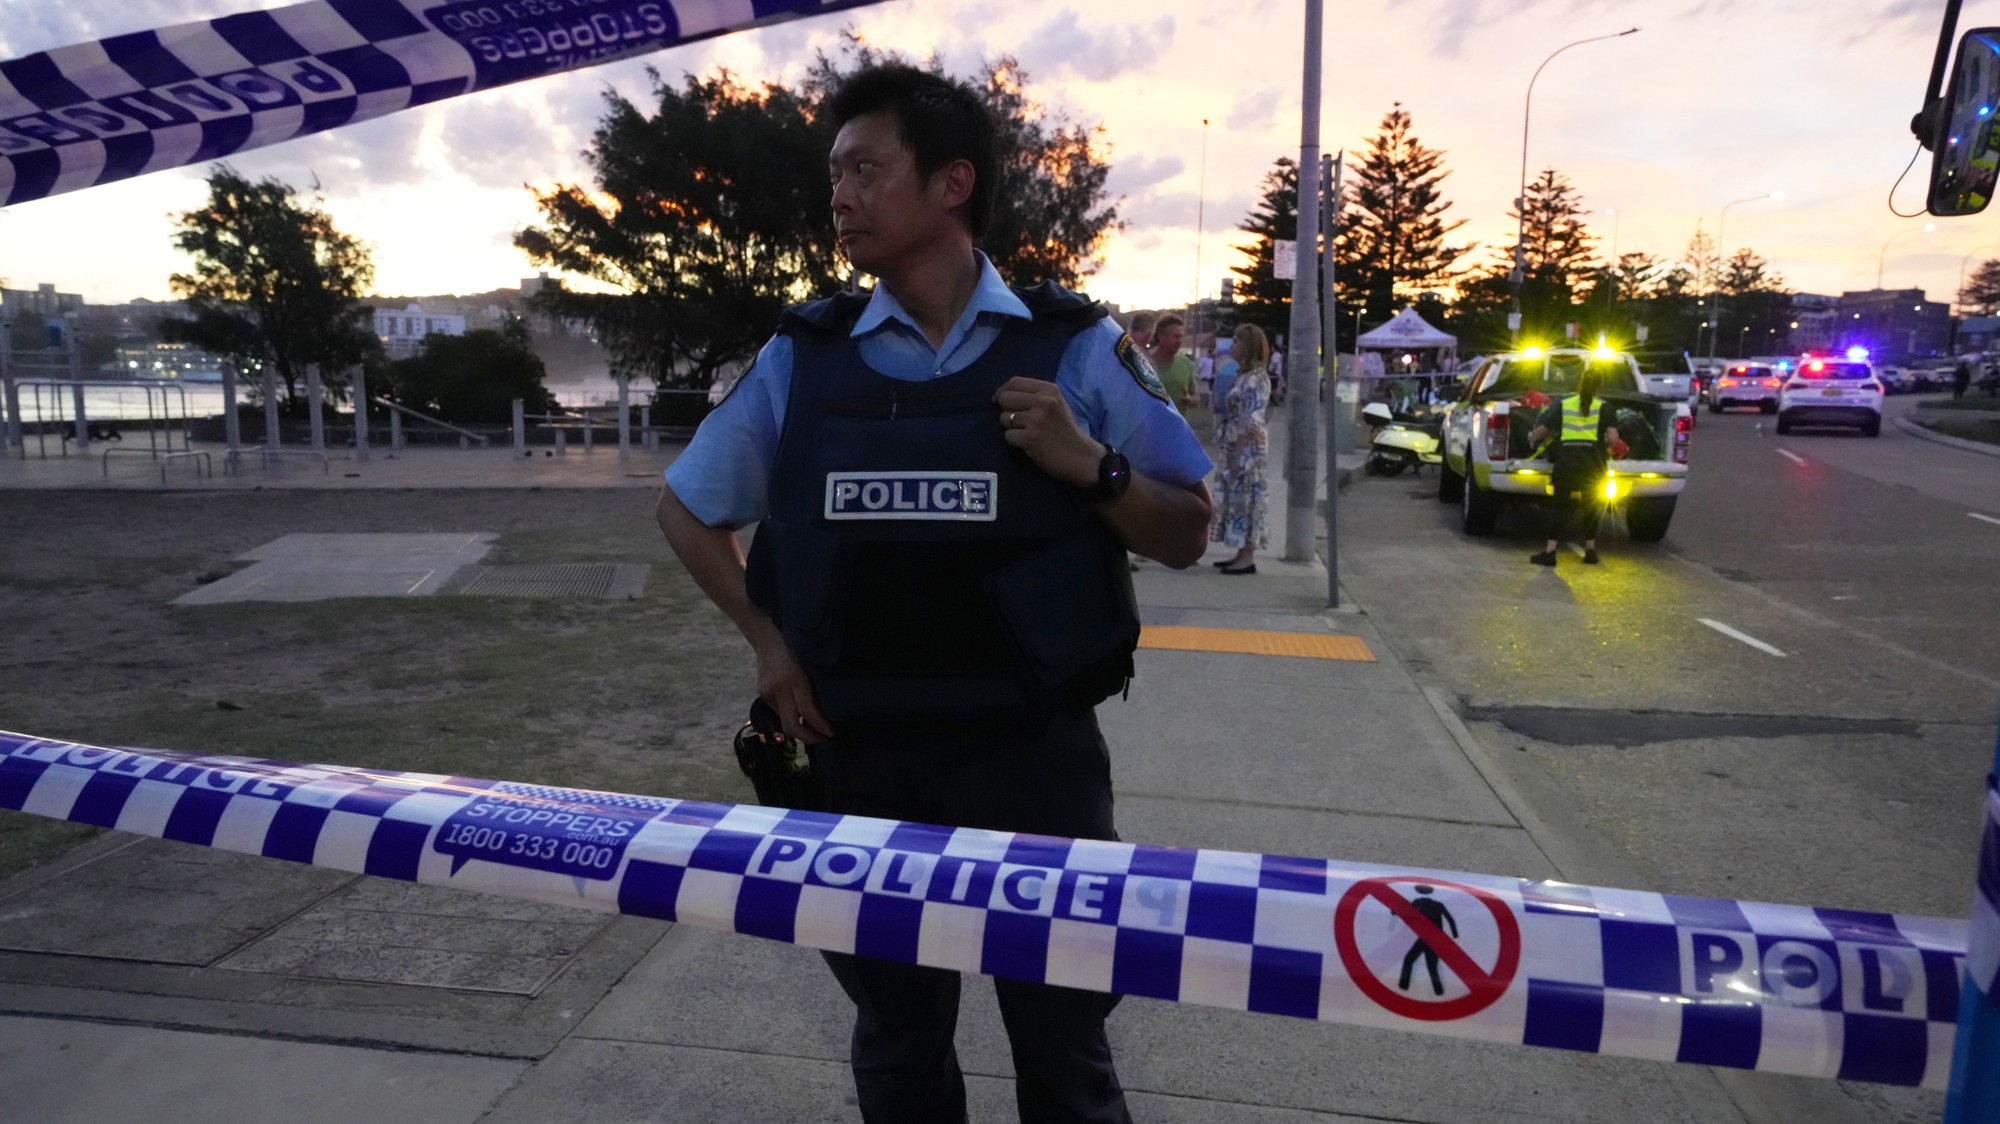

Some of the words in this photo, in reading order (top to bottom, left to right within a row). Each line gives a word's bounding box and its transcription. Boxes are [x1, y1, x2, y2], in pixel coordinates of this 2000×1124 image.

[471, 3, 667, 62] STOPPERS
[13, 60, 344, 141] POLICE
[836, 481, 986, 511] POLICE
[444, 823, 508, 851] 1800
[510, 834, 560, 859] 333
[562, 842, 614, 869] 000
[466, 803, 635, 838] STOPPERS
[757, 837, 1110, 920] POLICE
[1691, 932, 1960, 1013] POL
